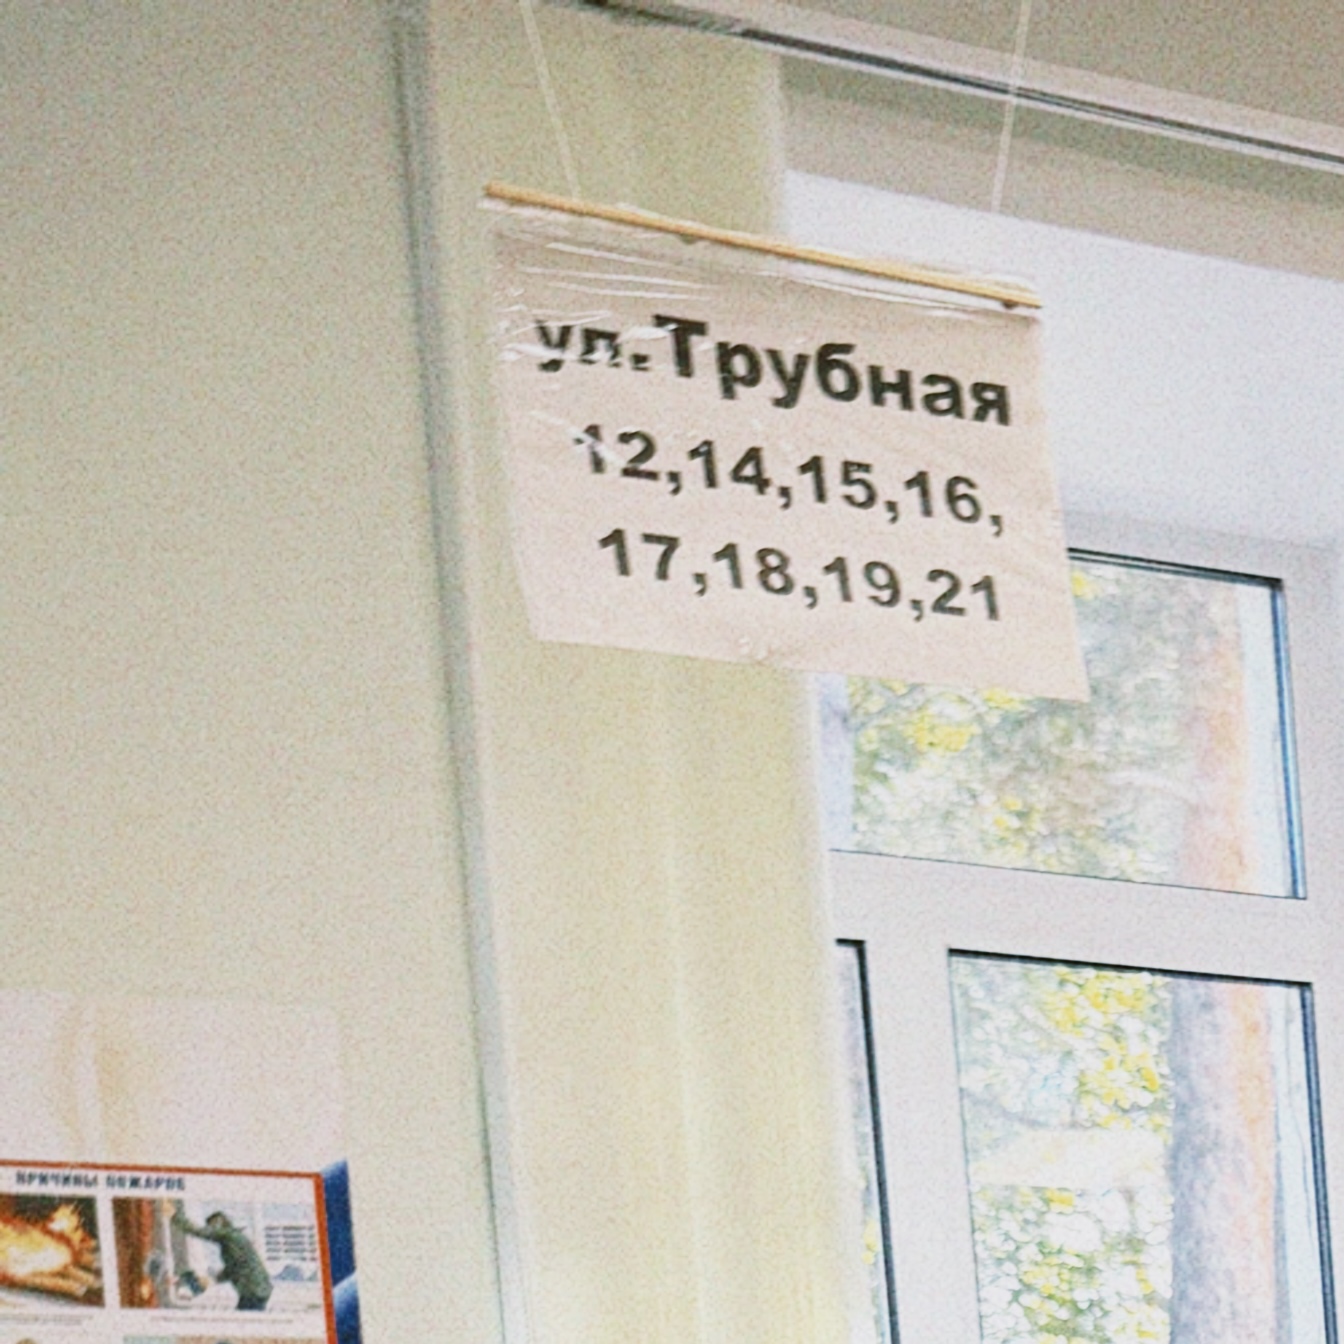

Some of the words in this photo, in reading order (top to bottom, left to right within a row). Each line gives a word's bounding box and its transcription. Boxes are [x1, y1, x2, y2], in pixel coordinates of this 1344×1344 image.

[535, 313, 1013, 427] ул.Трубная
[574, 423, 1004, 538] 12,14,15,16,
[598, 527, 1000, 622] 17,18,19,21
